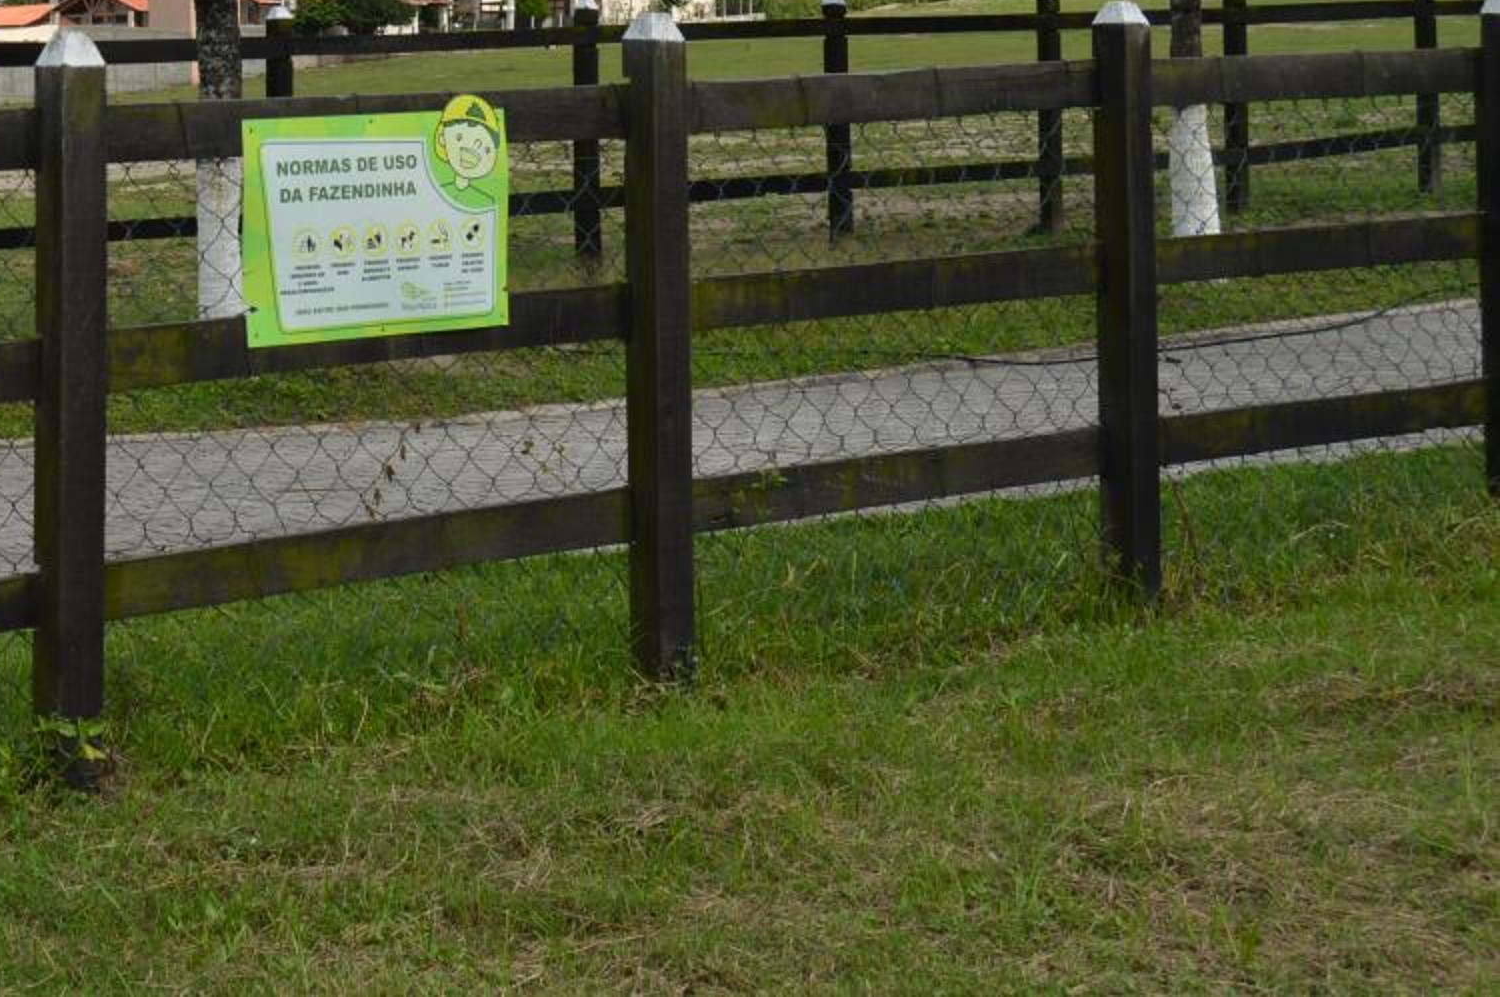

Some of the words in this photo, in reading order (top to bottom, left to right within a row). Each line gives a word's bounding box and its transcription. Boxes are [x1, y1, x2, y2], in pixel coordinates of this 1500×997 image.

[276, 158, 352, 177] NORMAS
[357, 156, 378, 172] DE
[383, 154, 418, 171] USO
[279, 188, 303, 203] DA
[309, 181, 417, 202] FAZENDINHA
